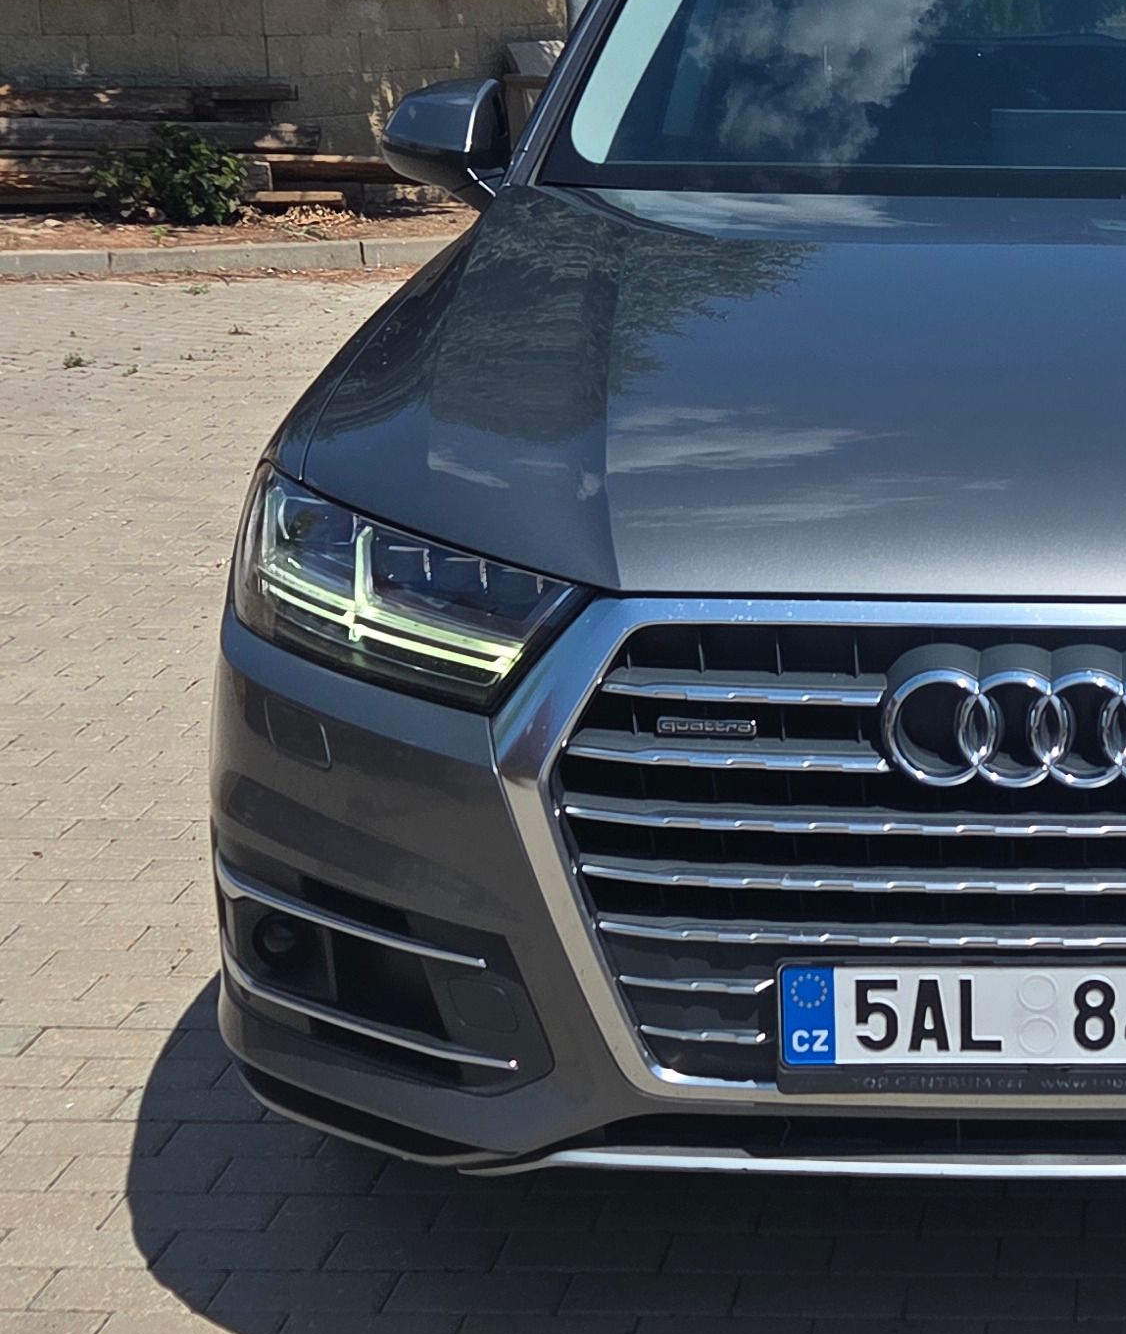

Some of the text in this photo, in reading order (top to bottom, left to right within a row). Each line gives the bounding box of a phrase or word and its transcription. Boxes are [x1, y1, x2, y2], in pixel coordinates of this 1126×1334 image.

[661, 721, 751, 734] quattro
[854, 978, 1003, 1052] 5AL
[792, 1029, 829, 1053] CZ
